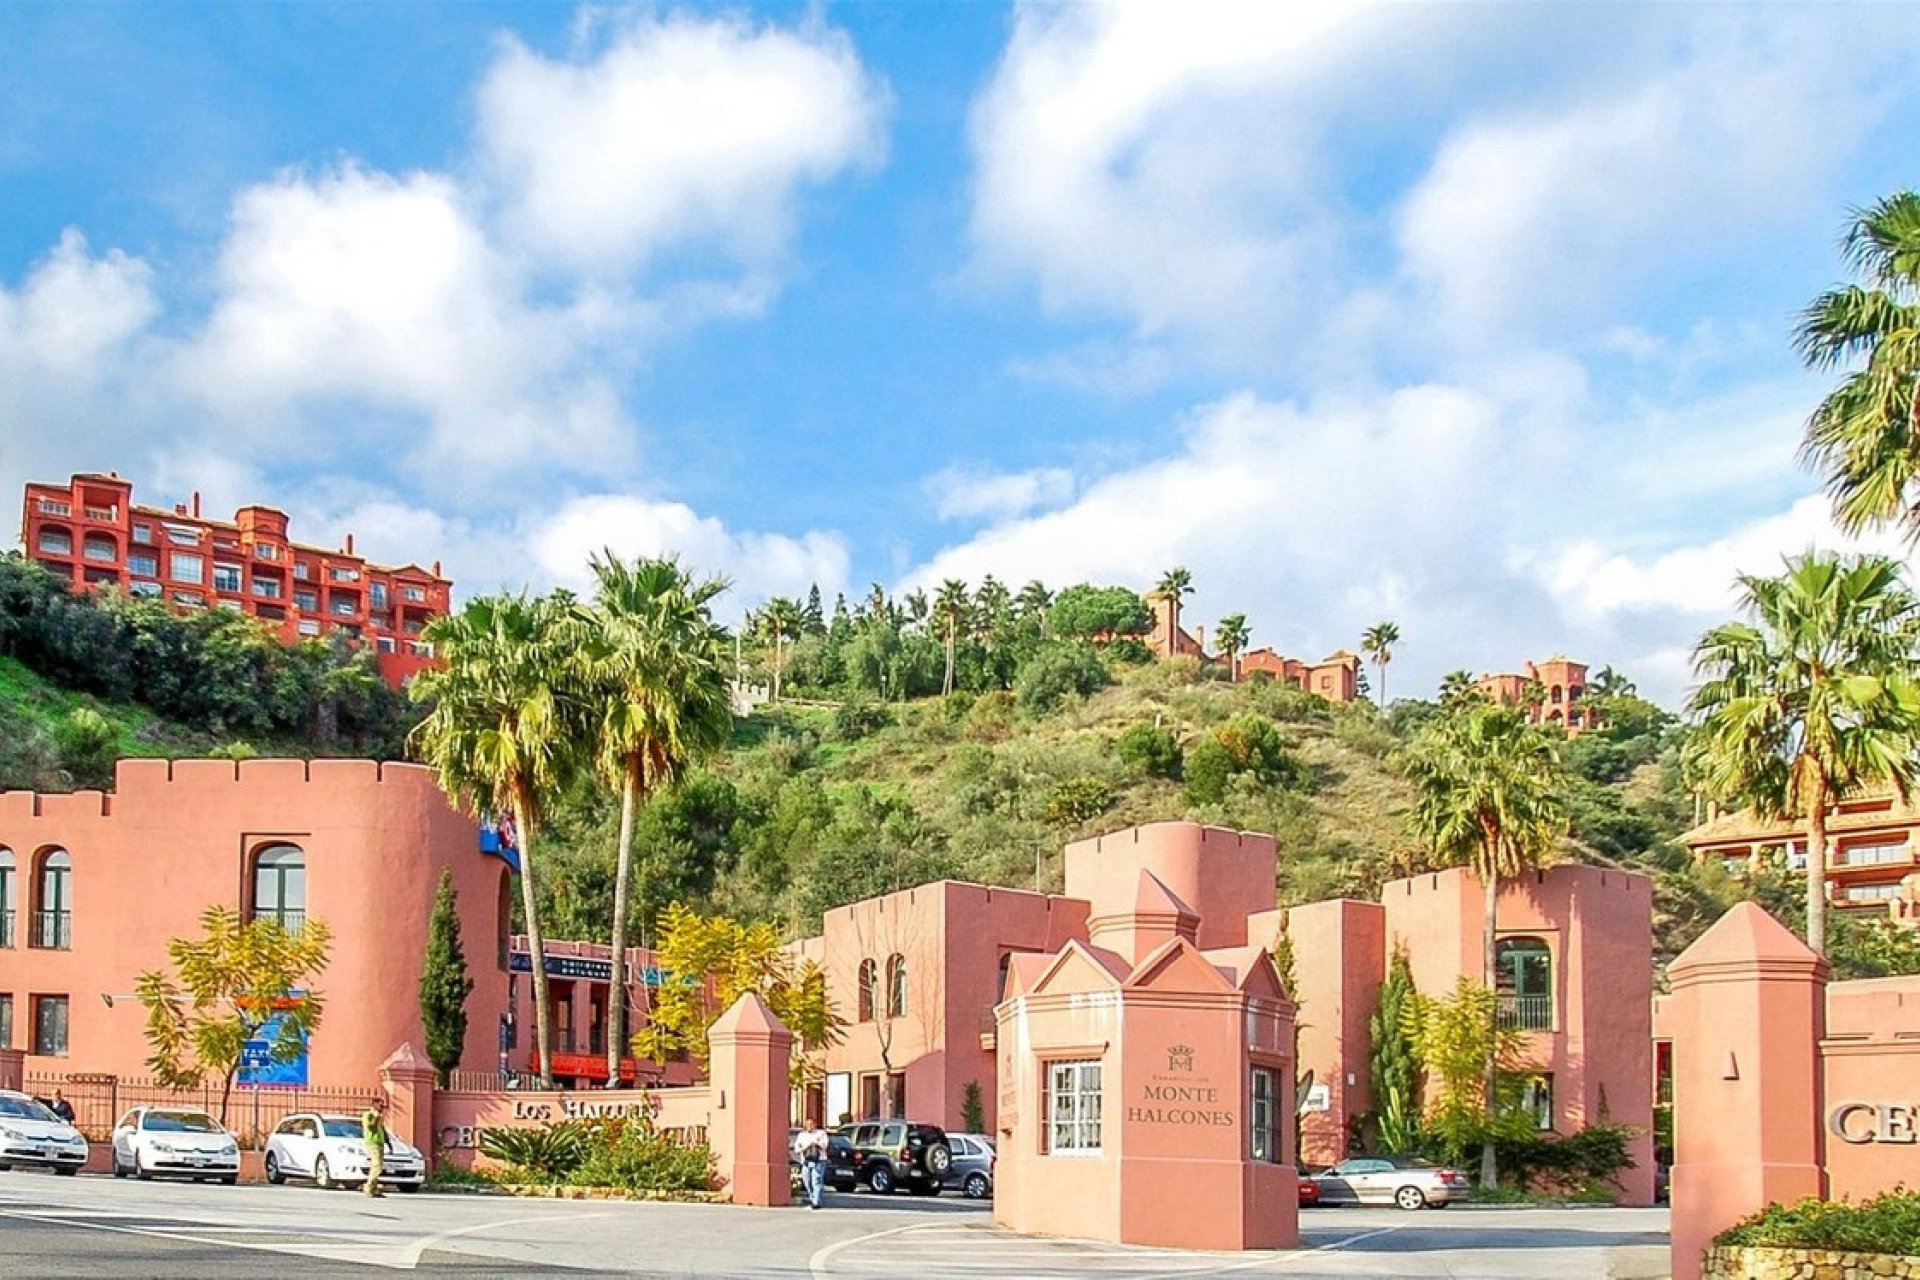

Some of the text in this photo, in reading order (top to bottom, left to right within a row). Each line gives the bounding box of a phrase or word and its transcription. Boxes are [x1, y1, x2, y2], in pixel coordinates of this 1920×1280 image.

[1143, 1085, 1218, 1103] MONTE
[1126, 1106, 1235, 1127] HALCONES
[1829, 1101, 1920, 1145] CE
